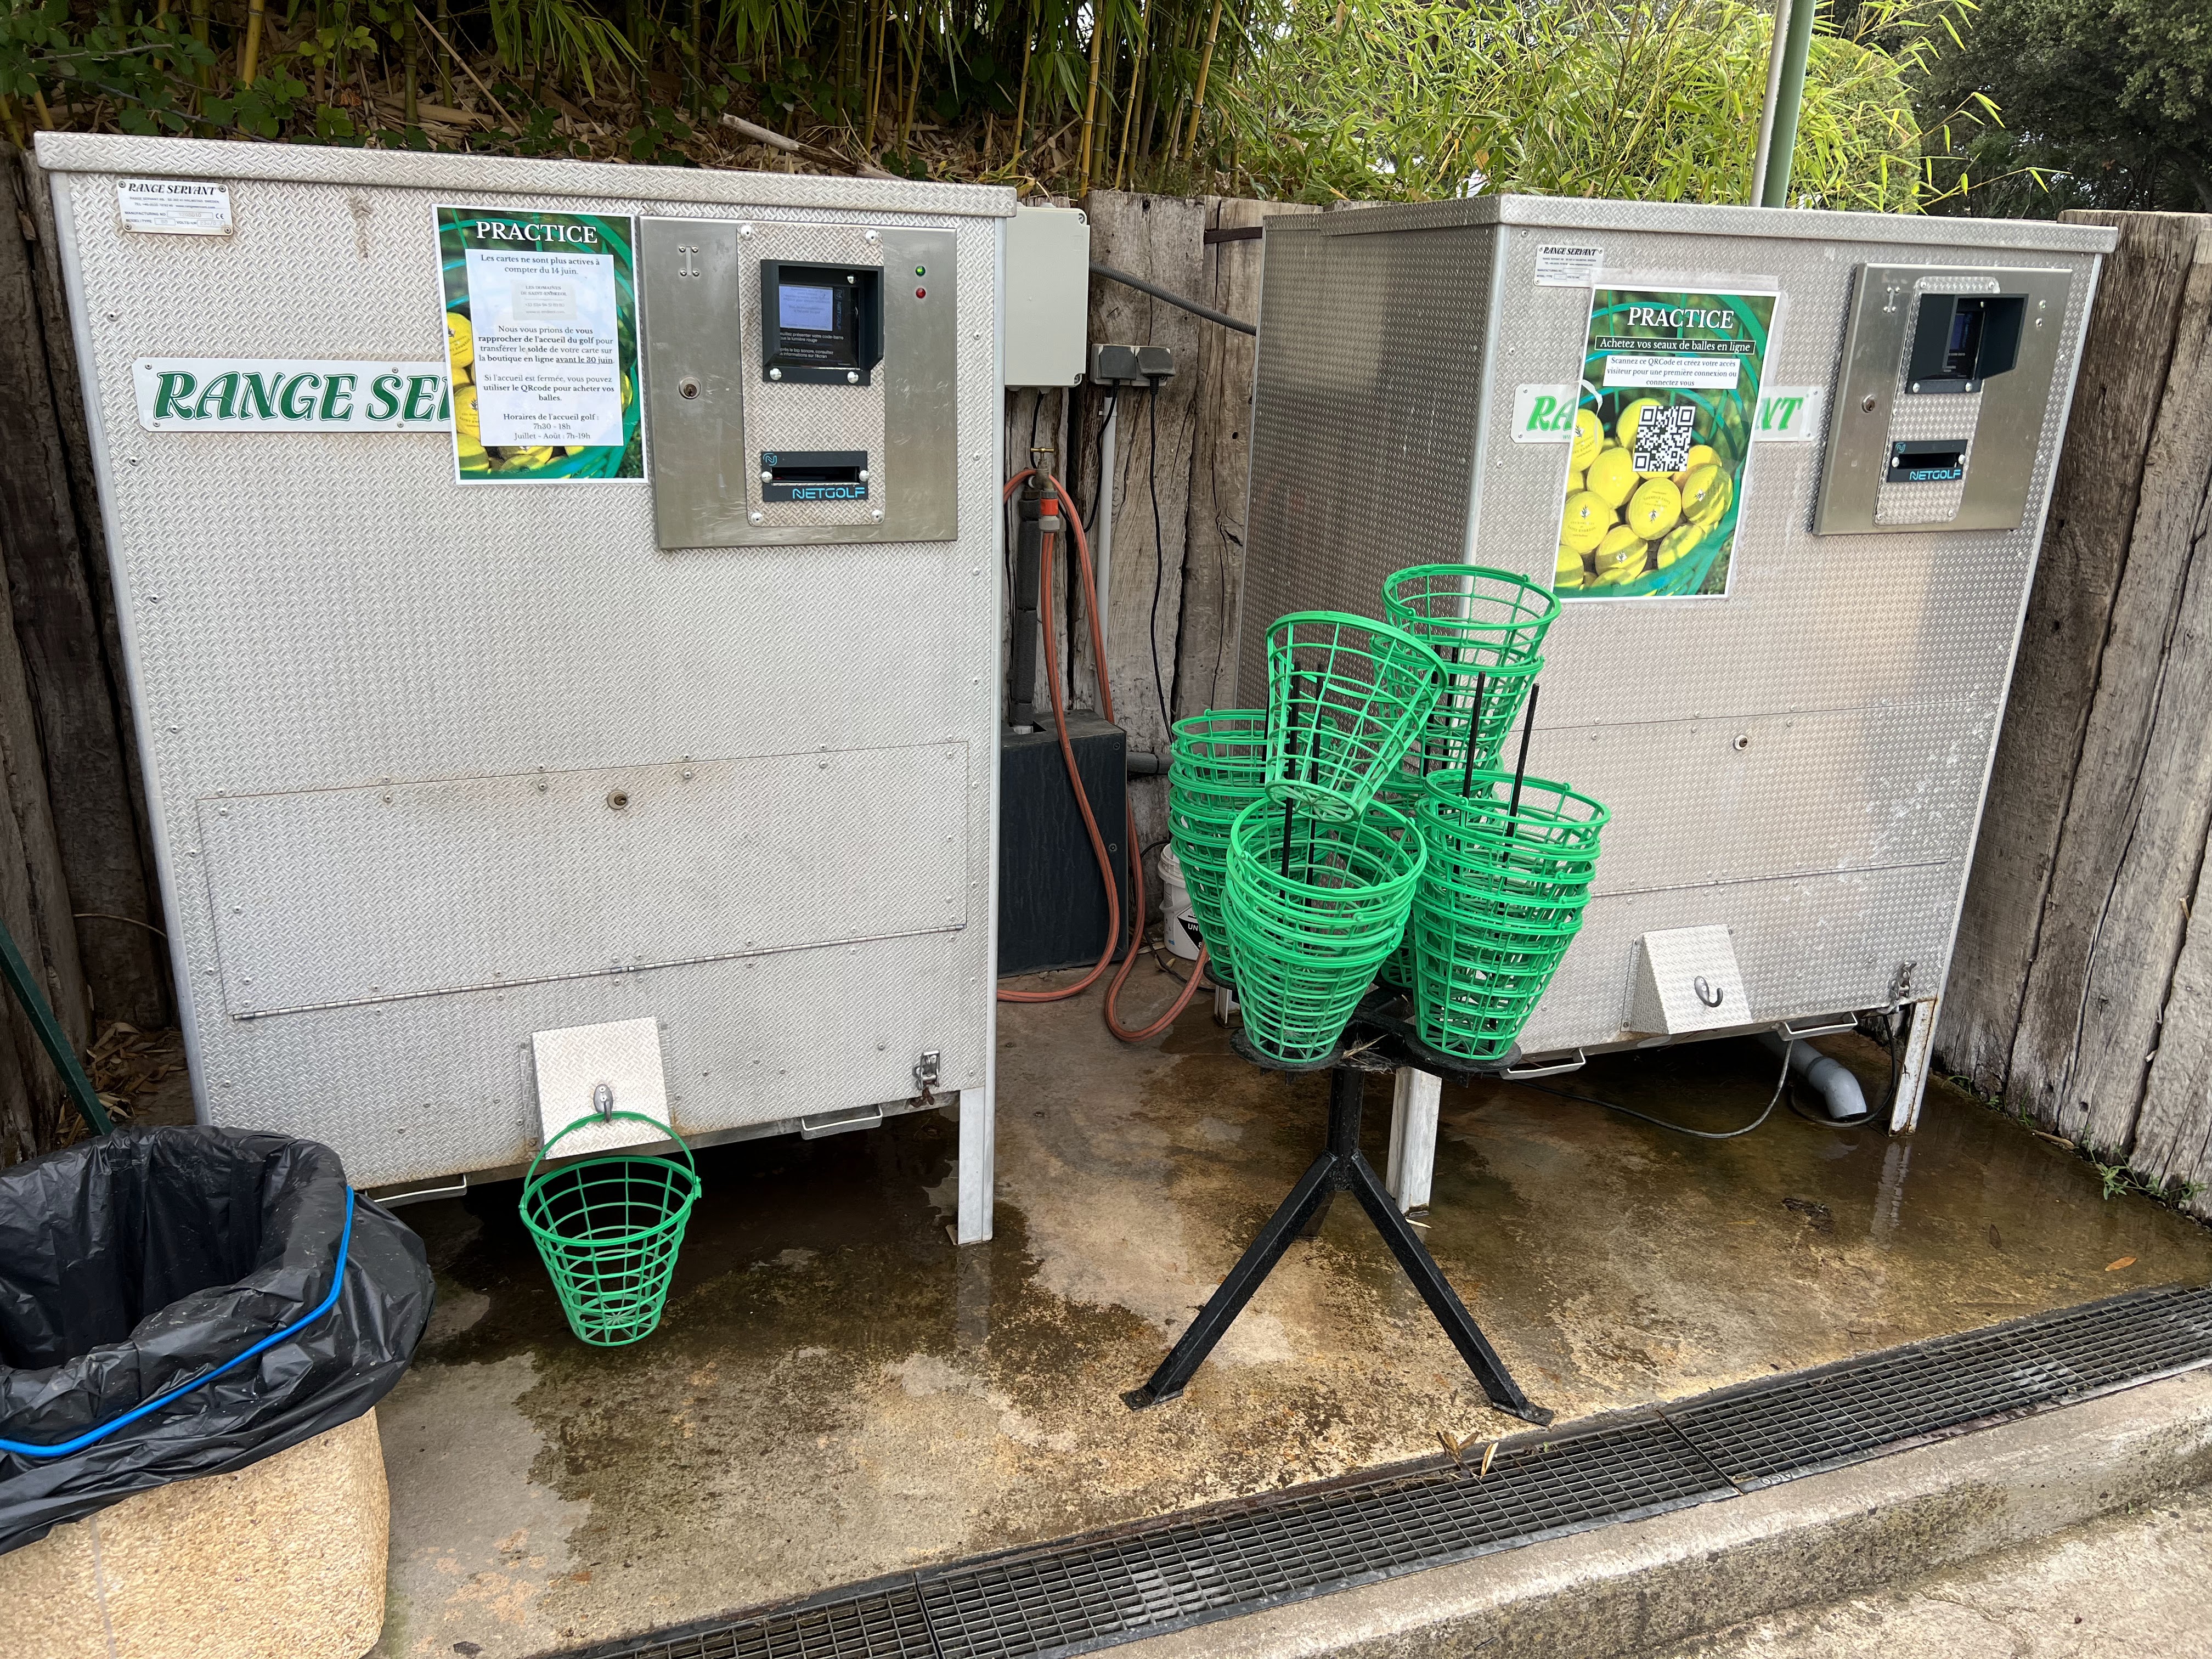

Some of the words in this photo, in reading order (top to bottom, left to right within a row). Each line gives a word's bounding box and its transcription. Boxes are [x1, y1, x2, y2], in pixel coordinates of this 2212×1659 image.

[129, 183, 165, 193] RANGE
[167, 185, 215, 195] SERVANT
[476, 221, 597, 244] PRACTICE
[1627, 307, 1734, 329] PRACTICE
[1600, 338, 1634, 349] Achetez
[1637, 341, 1651, 349] vos
[1653, 341, 1677, 349] seaux
[1679, 340, 1690, 350] de
[1692, 341, 1715, 351] balles
[1730, 341, 1750, 353] ligne
[488, 355, 522, 363] boutique
[535, 356, 554, 364] ligne
[1648, 358, 1675, 366] QRCode
[1684, 358, 1701, 366] créez
[538, 375, 565, 383] fermée,
[1663, 369, 1693, 377] première
[153, 371, 357, 422] RANGE
[365, 374, 451, 422] SE
[1910, 469, 1961, 481] NETGOLF
[793, 487, 865, 499] NETGOLF
